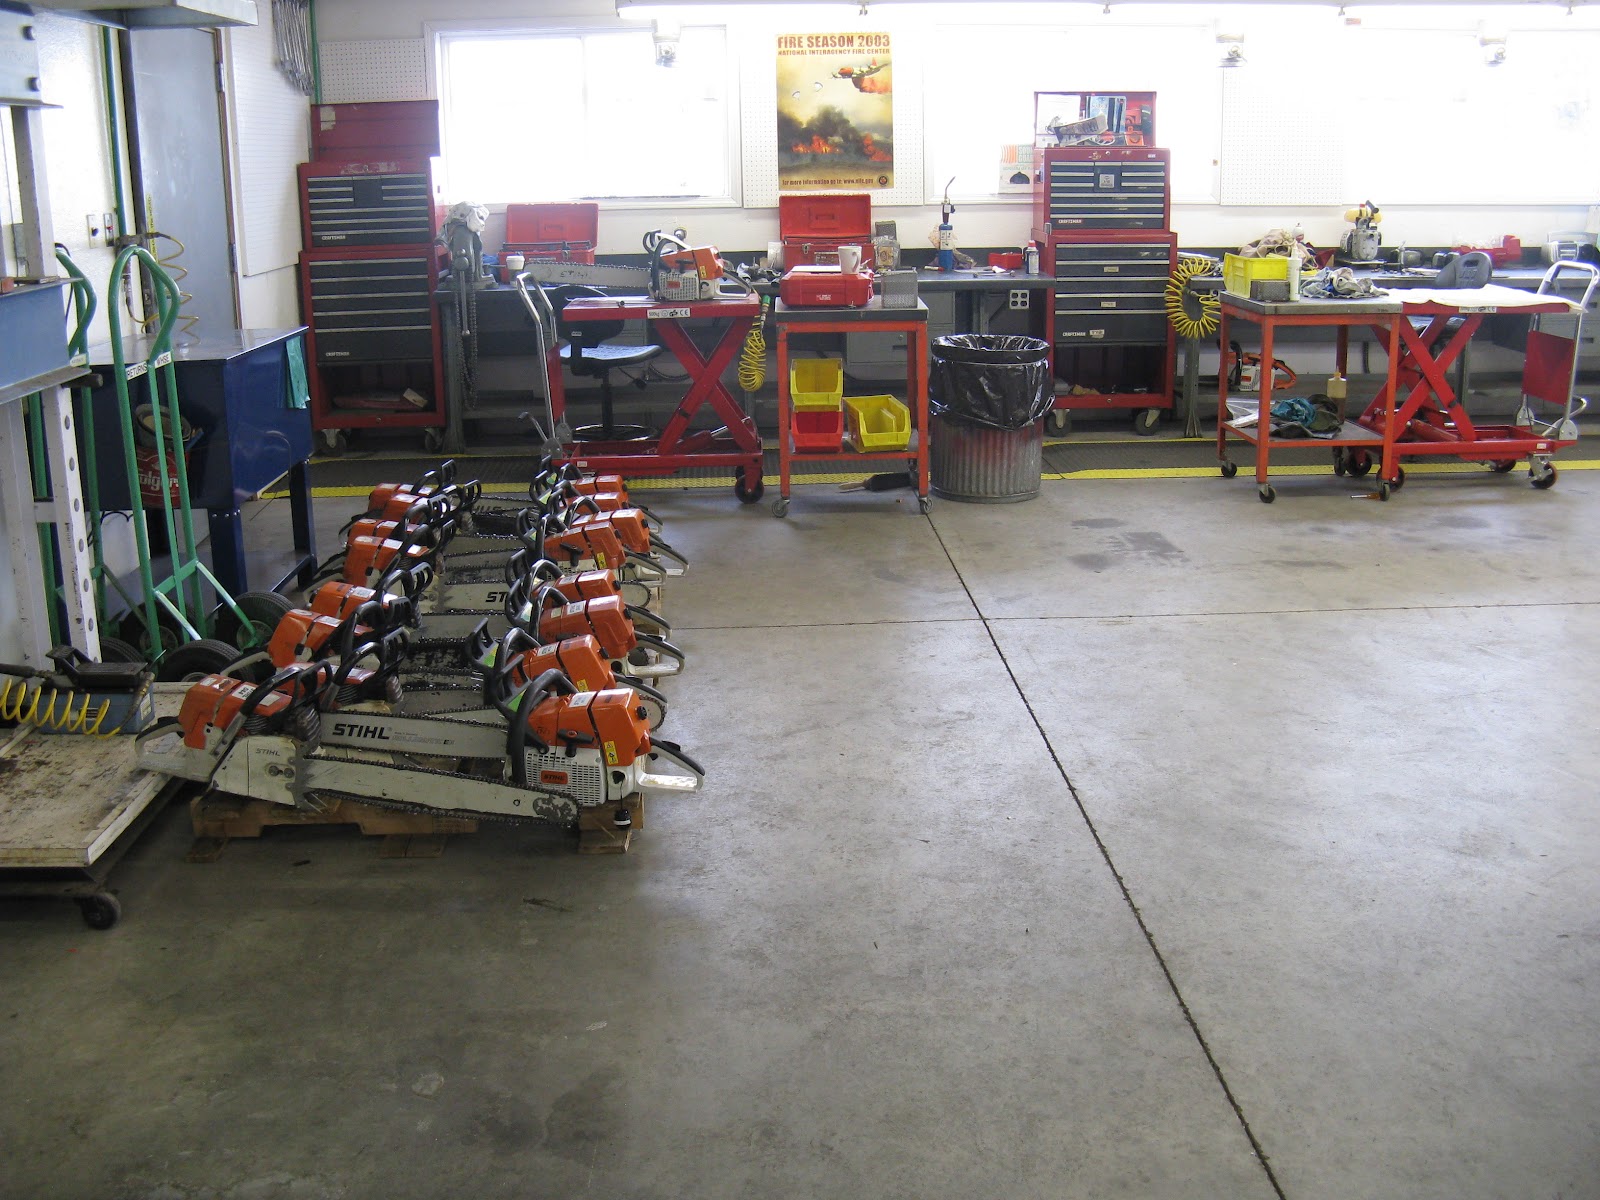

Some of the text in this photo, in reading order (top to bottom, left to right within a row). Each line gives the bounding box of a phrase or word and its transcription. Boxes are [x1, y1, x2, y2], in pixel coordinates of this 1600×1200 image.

[777, 34, 890, 49] FIRE SEASON 2003
[126, 363, 148, 378] RETURNS
[332, 723, 390, 740] STIHL
[255, 748, 280, 757] STIHL
